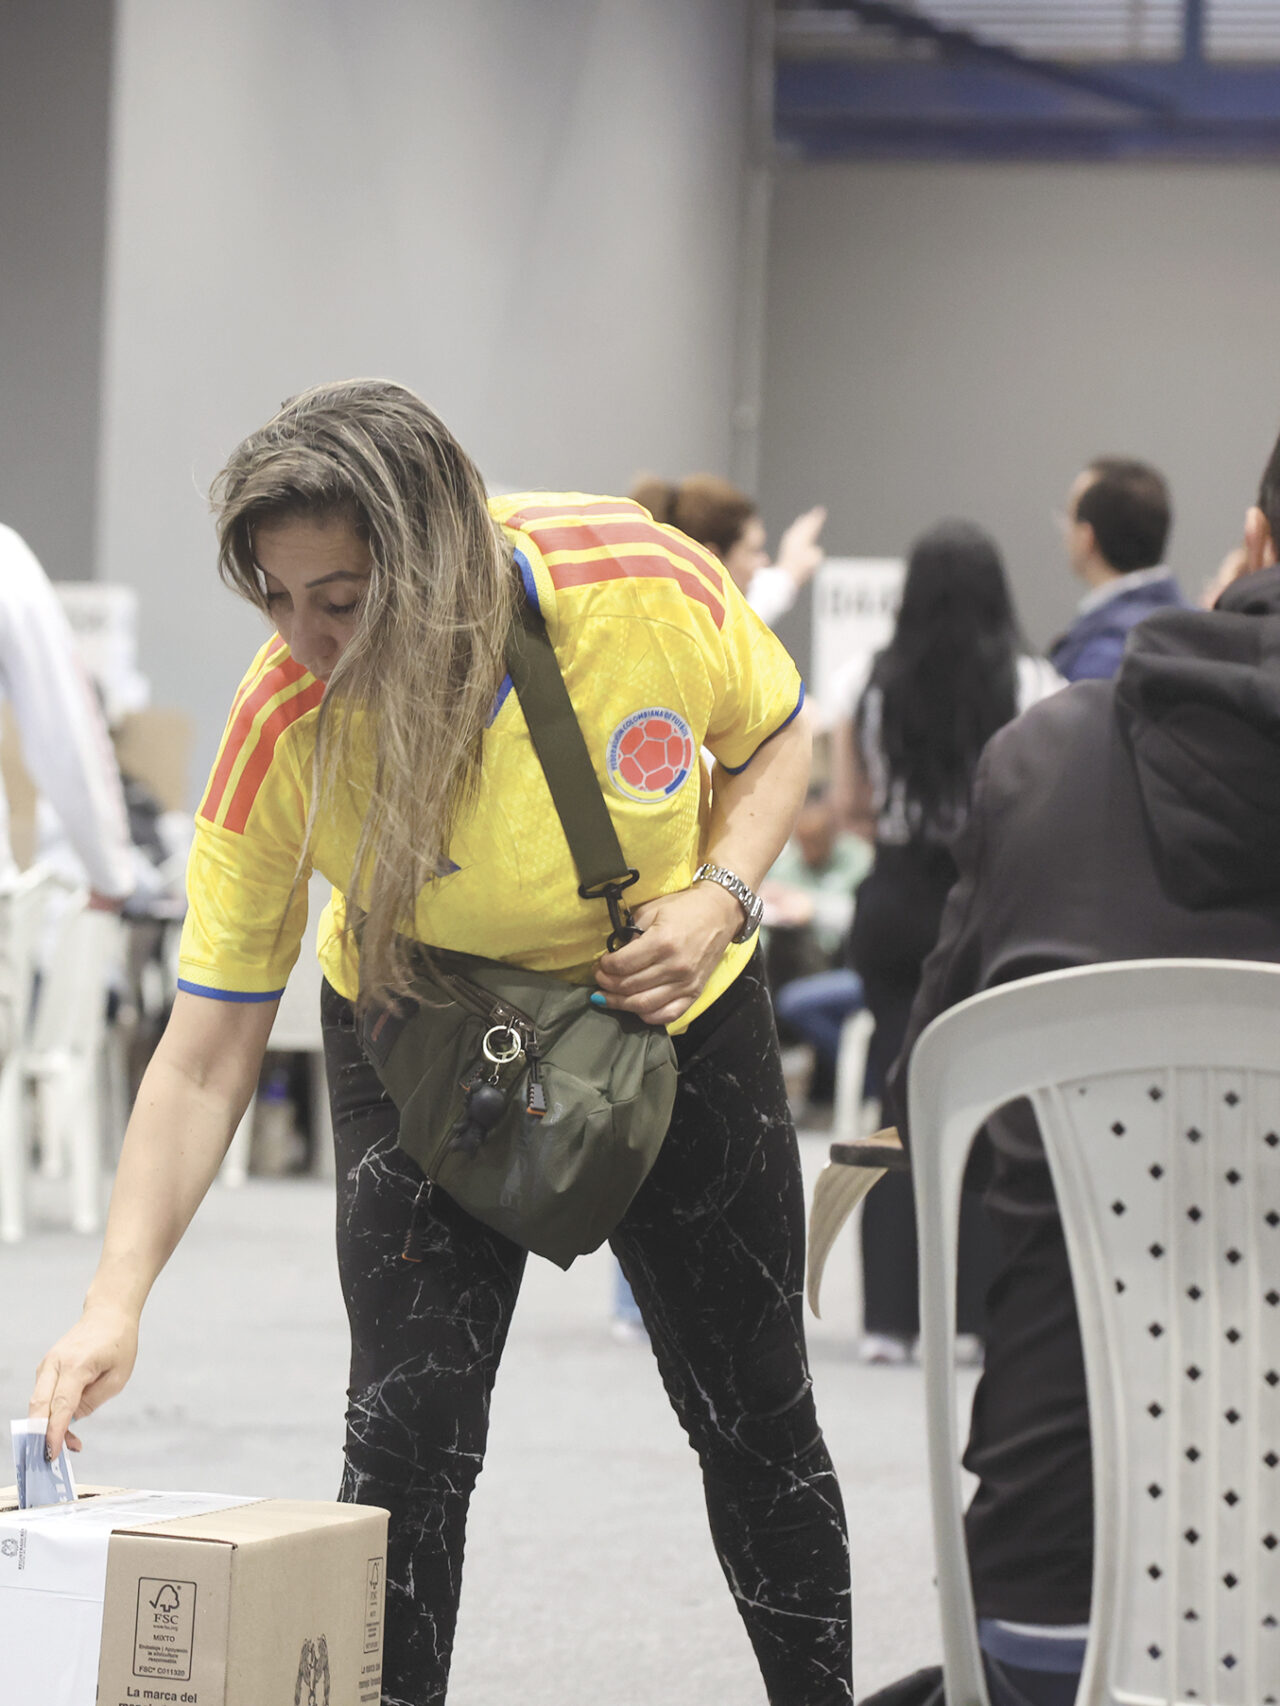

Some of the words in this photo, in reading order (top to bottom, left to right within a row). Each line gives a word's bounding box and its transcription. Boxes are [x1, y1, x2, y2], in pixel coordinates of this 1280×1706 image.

[623, 709, 664, 730] COLOMBIANA
[153, 1613, 179, 1624] FSC
[153, 1634, 176, 1642] MIXTO
[127, 1686, 140, 1697] La
[143, 1690, 177, 1701] marca
[180, 1692, 197, 1703] del
